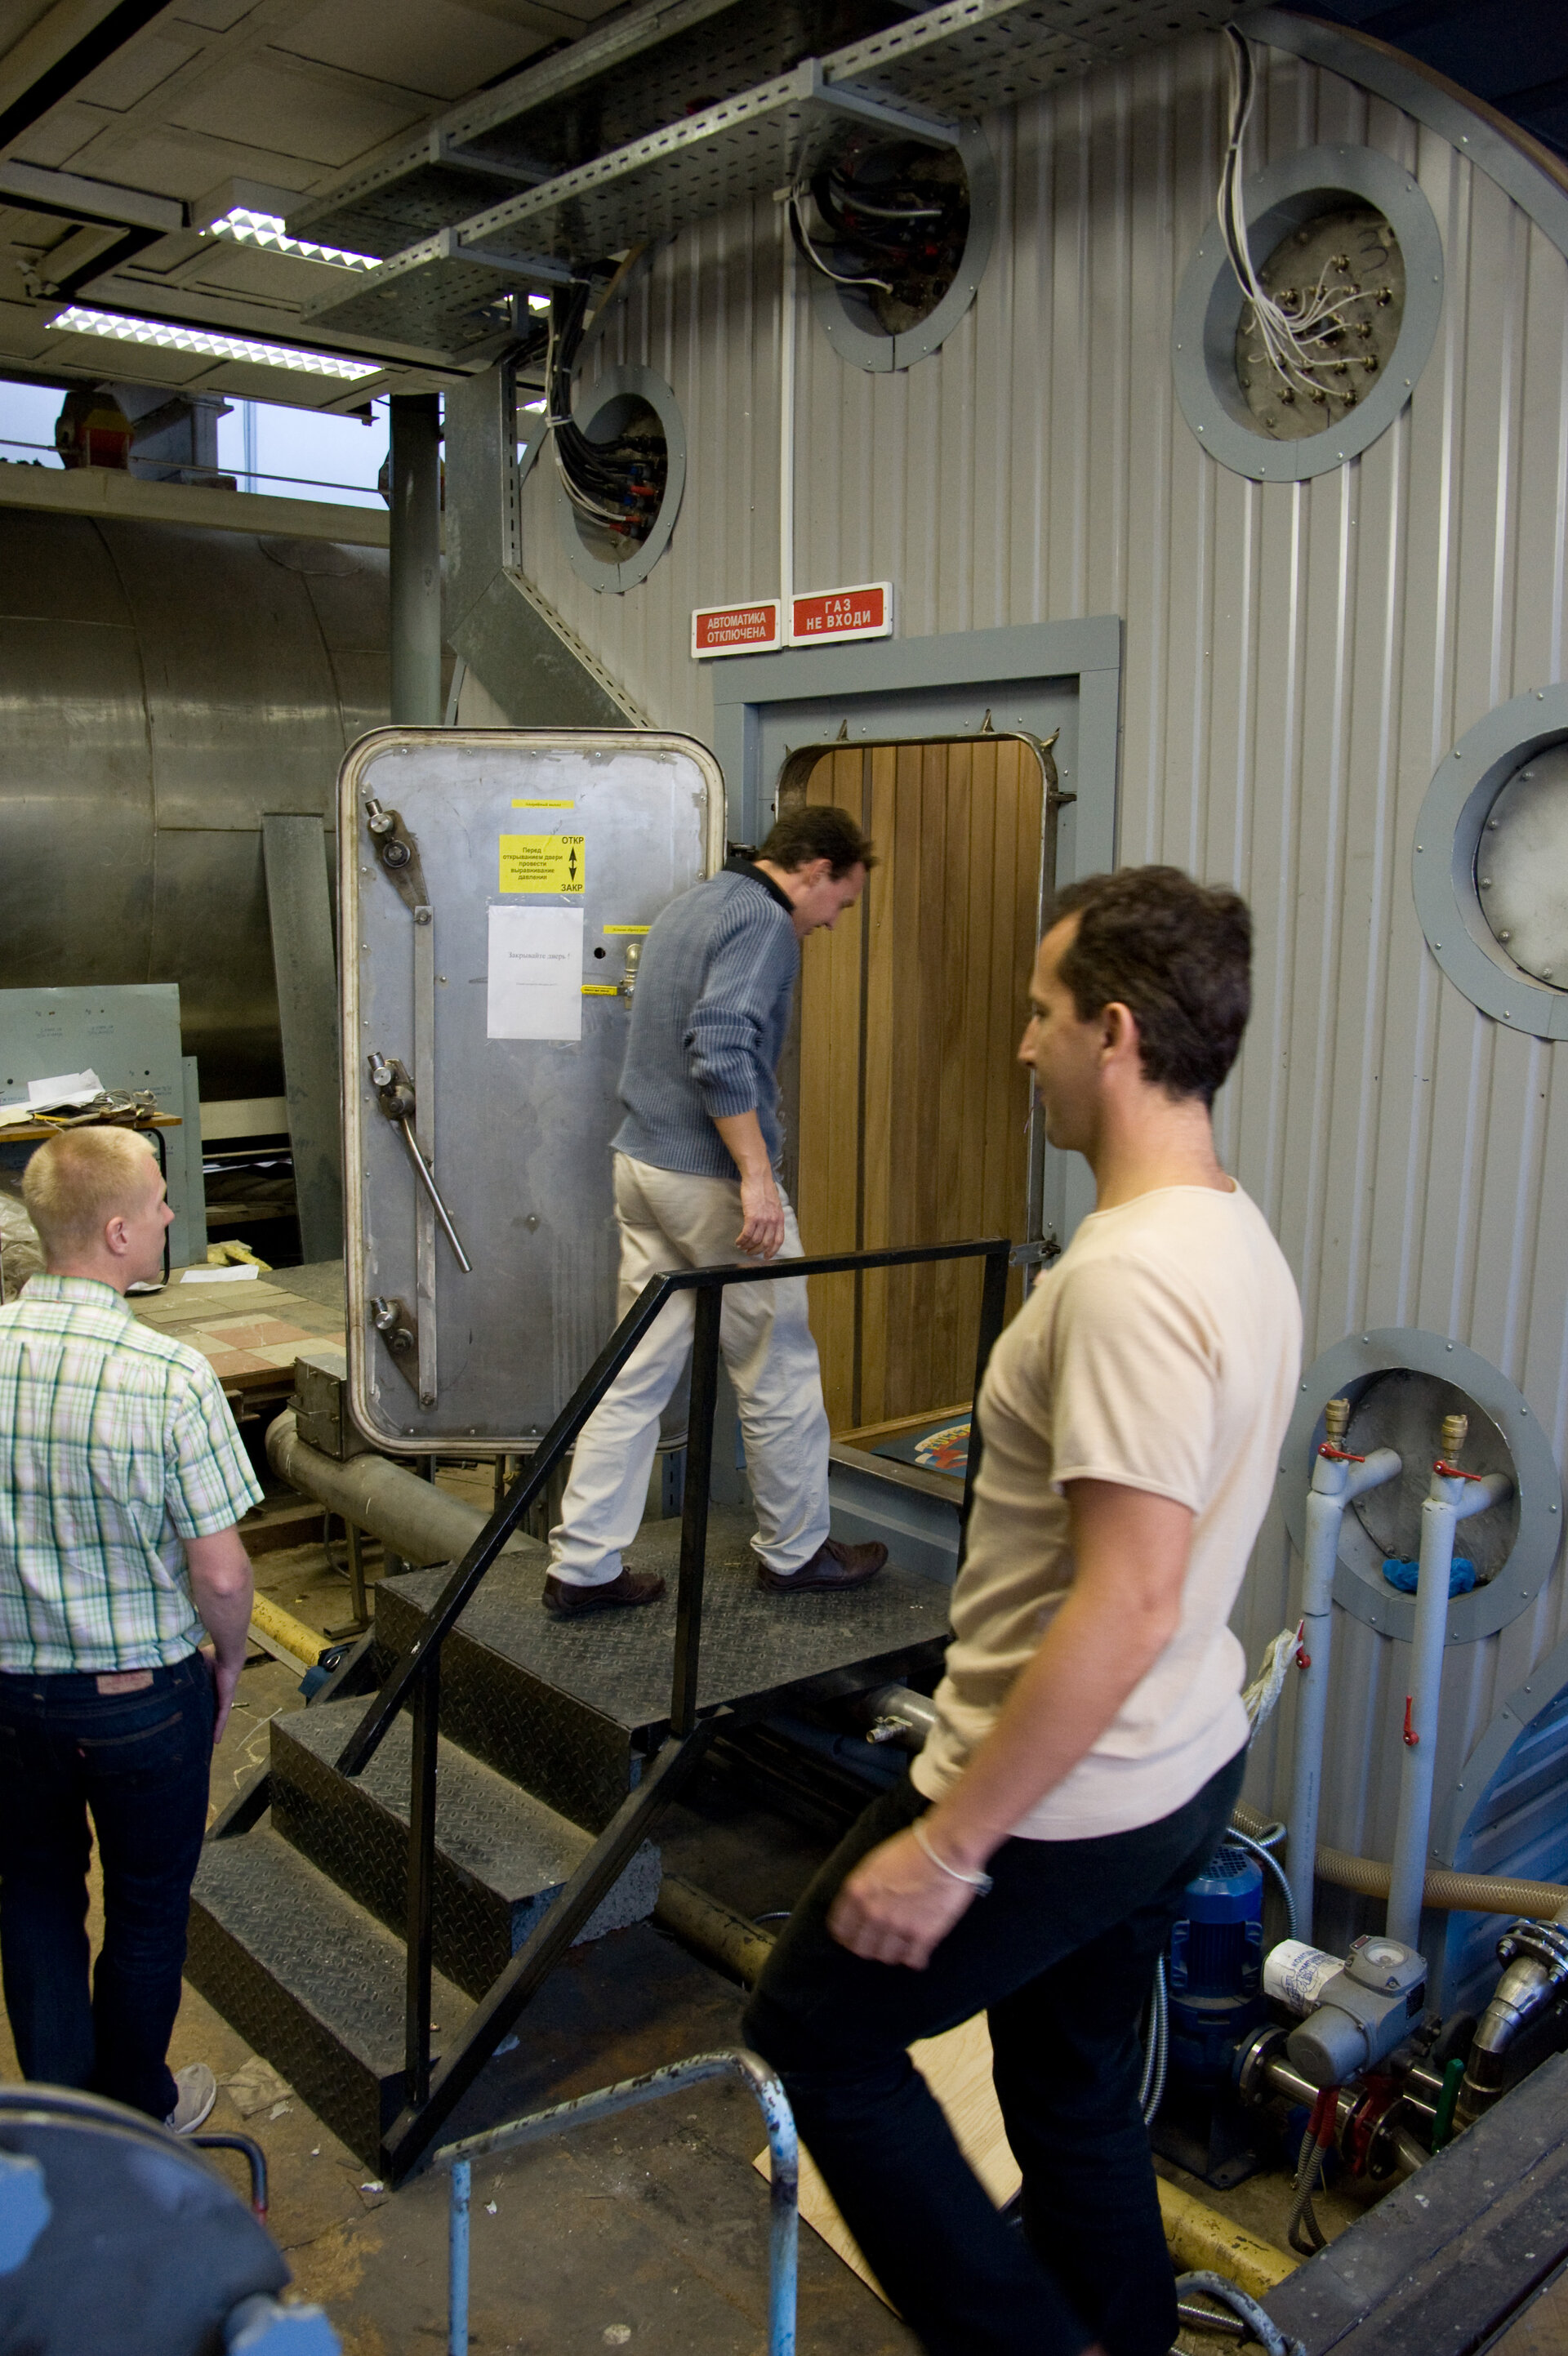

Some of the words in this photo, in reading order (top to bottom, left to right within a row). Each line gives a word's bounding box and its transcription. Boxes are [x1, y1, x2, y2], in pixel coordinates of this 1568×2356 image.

[825, 598, 851, 613] ГАЗ
[707, 612, 766, 630] АВТОМАТИКА
[807, 617, 822, 630] НЕ
[826, 610, 871, 628] ВХОДИ
[707, 627, 766, 644] ОТКЛЮЧЕНА
[561, 836, 584, 844] ОТКР
[561, 884, 583, 892] ЗАКР
[509, 951, 546, 960] Закрывайте
[546, 953, 566, 961] дверь
